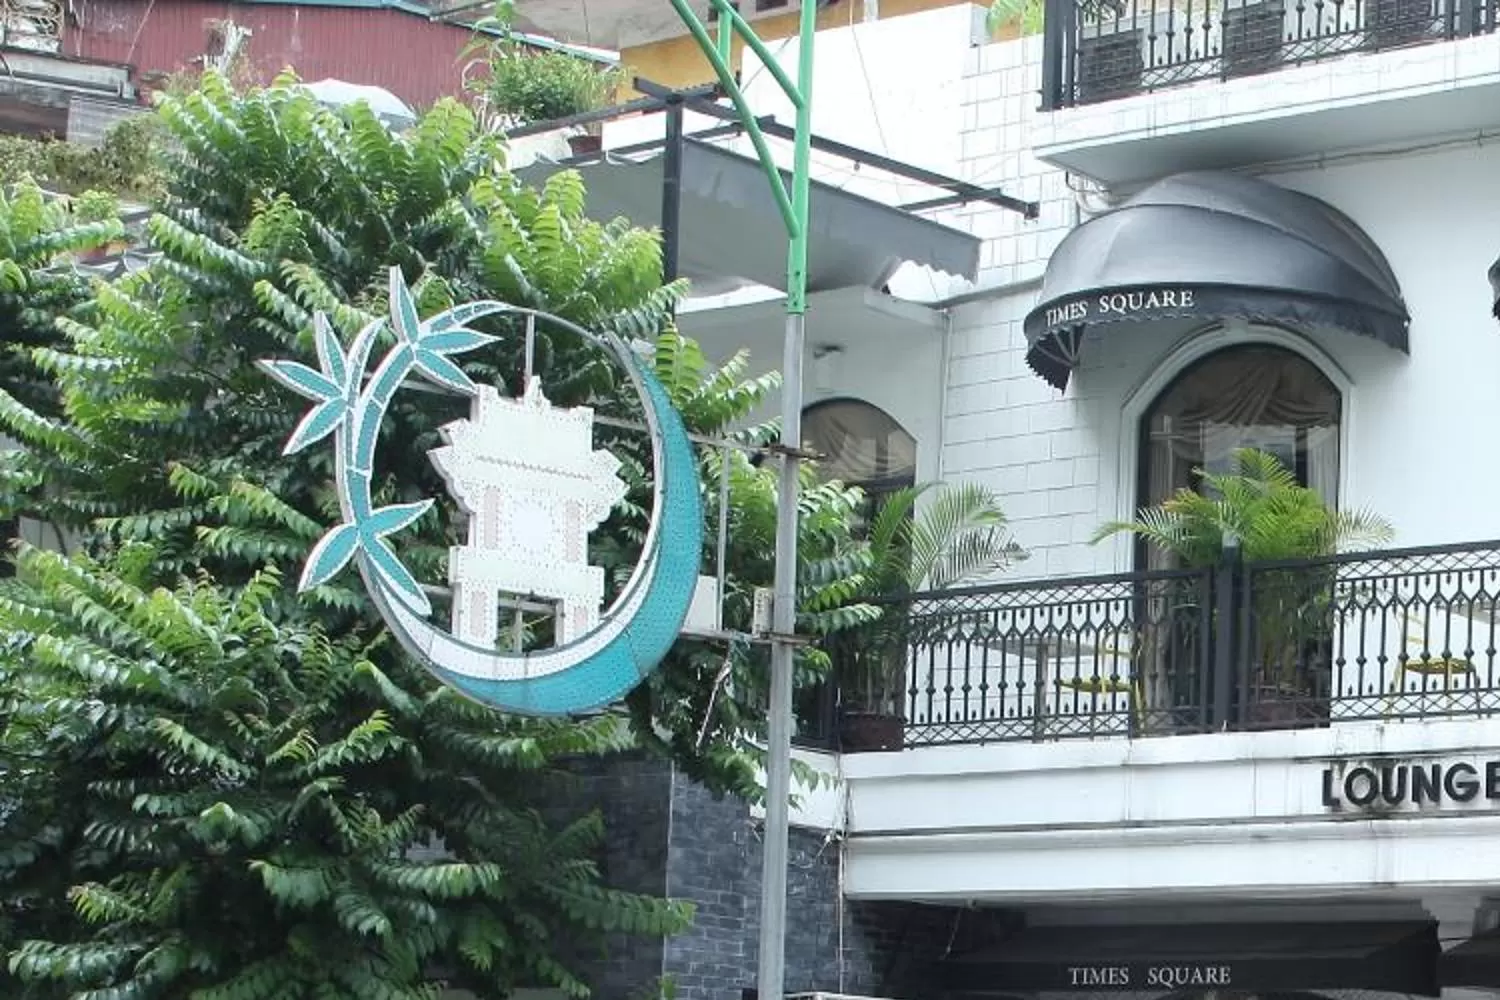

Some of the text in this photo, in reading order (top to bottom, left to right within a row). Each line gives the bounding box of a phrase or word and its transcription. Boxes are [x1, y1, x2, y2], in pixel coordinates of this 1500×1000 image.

[1045, 290, 1195, 327] TIMES SQUARE
[1068, 967, 1232, 989] TIMES SQUARE
